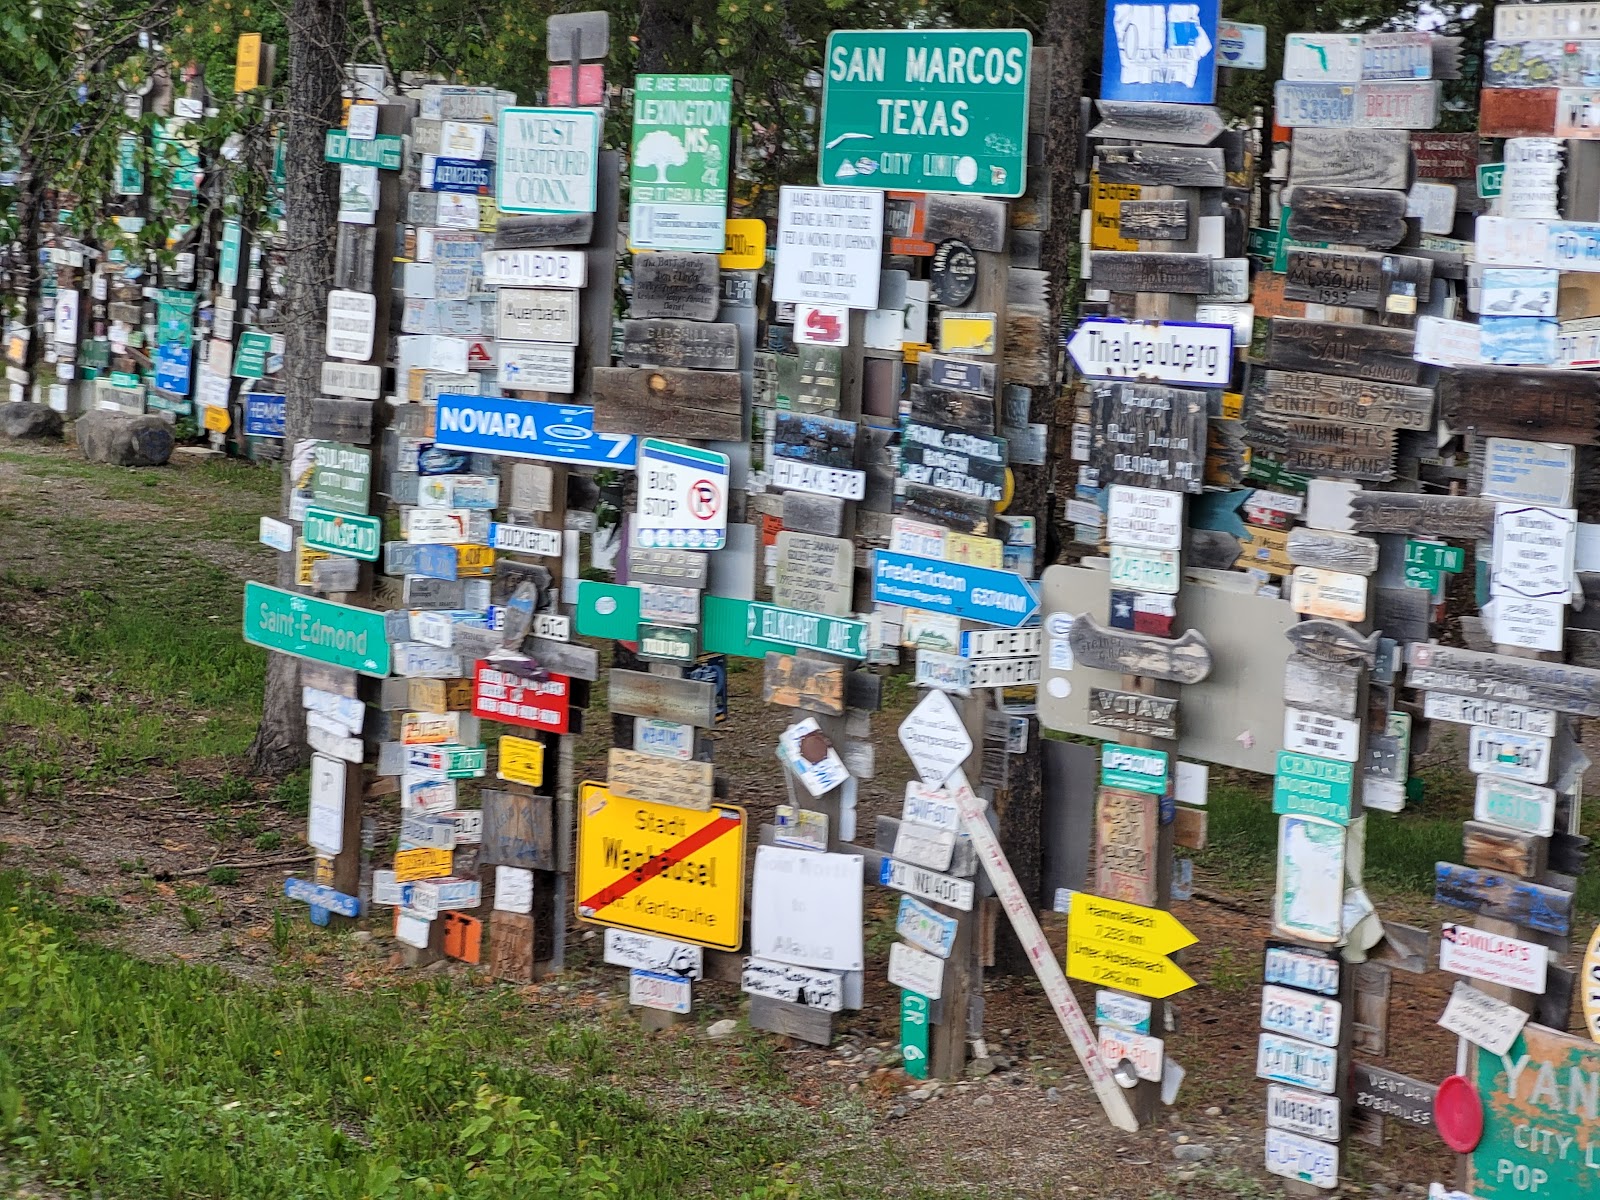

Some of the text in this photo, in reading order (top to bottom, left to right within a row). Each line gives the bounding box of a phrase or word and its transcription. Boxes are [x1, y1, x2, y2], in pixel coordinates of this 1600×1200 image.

[830, 46, 1023, 85] SAN MARCOS
[634, 99, 730, 126] LEXINGTON
[877, 99, 969, 137] TEXAS
[519, 118, 577, 146] WEST
[506, 149, 589, 176] HARTFORD
[880, 152, 912, 175] CITY
[1289, 269, 1371, 291] MISSOURI
[1087, 330, 1219, 376] Thalgauberg
[440, 406, 538, 441] NOVARA
[598, 433, 633, 459] 7
[647, 470, 677, 492] BUS
[642, 497, 678, 519] STOP
[877, 559, 966, 592] Fredericton
[259, 602, 368, 656] Saint-Edmond
[762, 609, 820, 645] ELKHART
[1281, 755, 1349, 783] CENTER
[1276, 776, 1331, 798] NORTH
[1287, 795, 1349, 820] DAKOTA
[634, 809, 686, 836] Stadt
[633, 895, 719, 929] Karlsruhe
[1513, 1124, 1573, 1160] CITY
